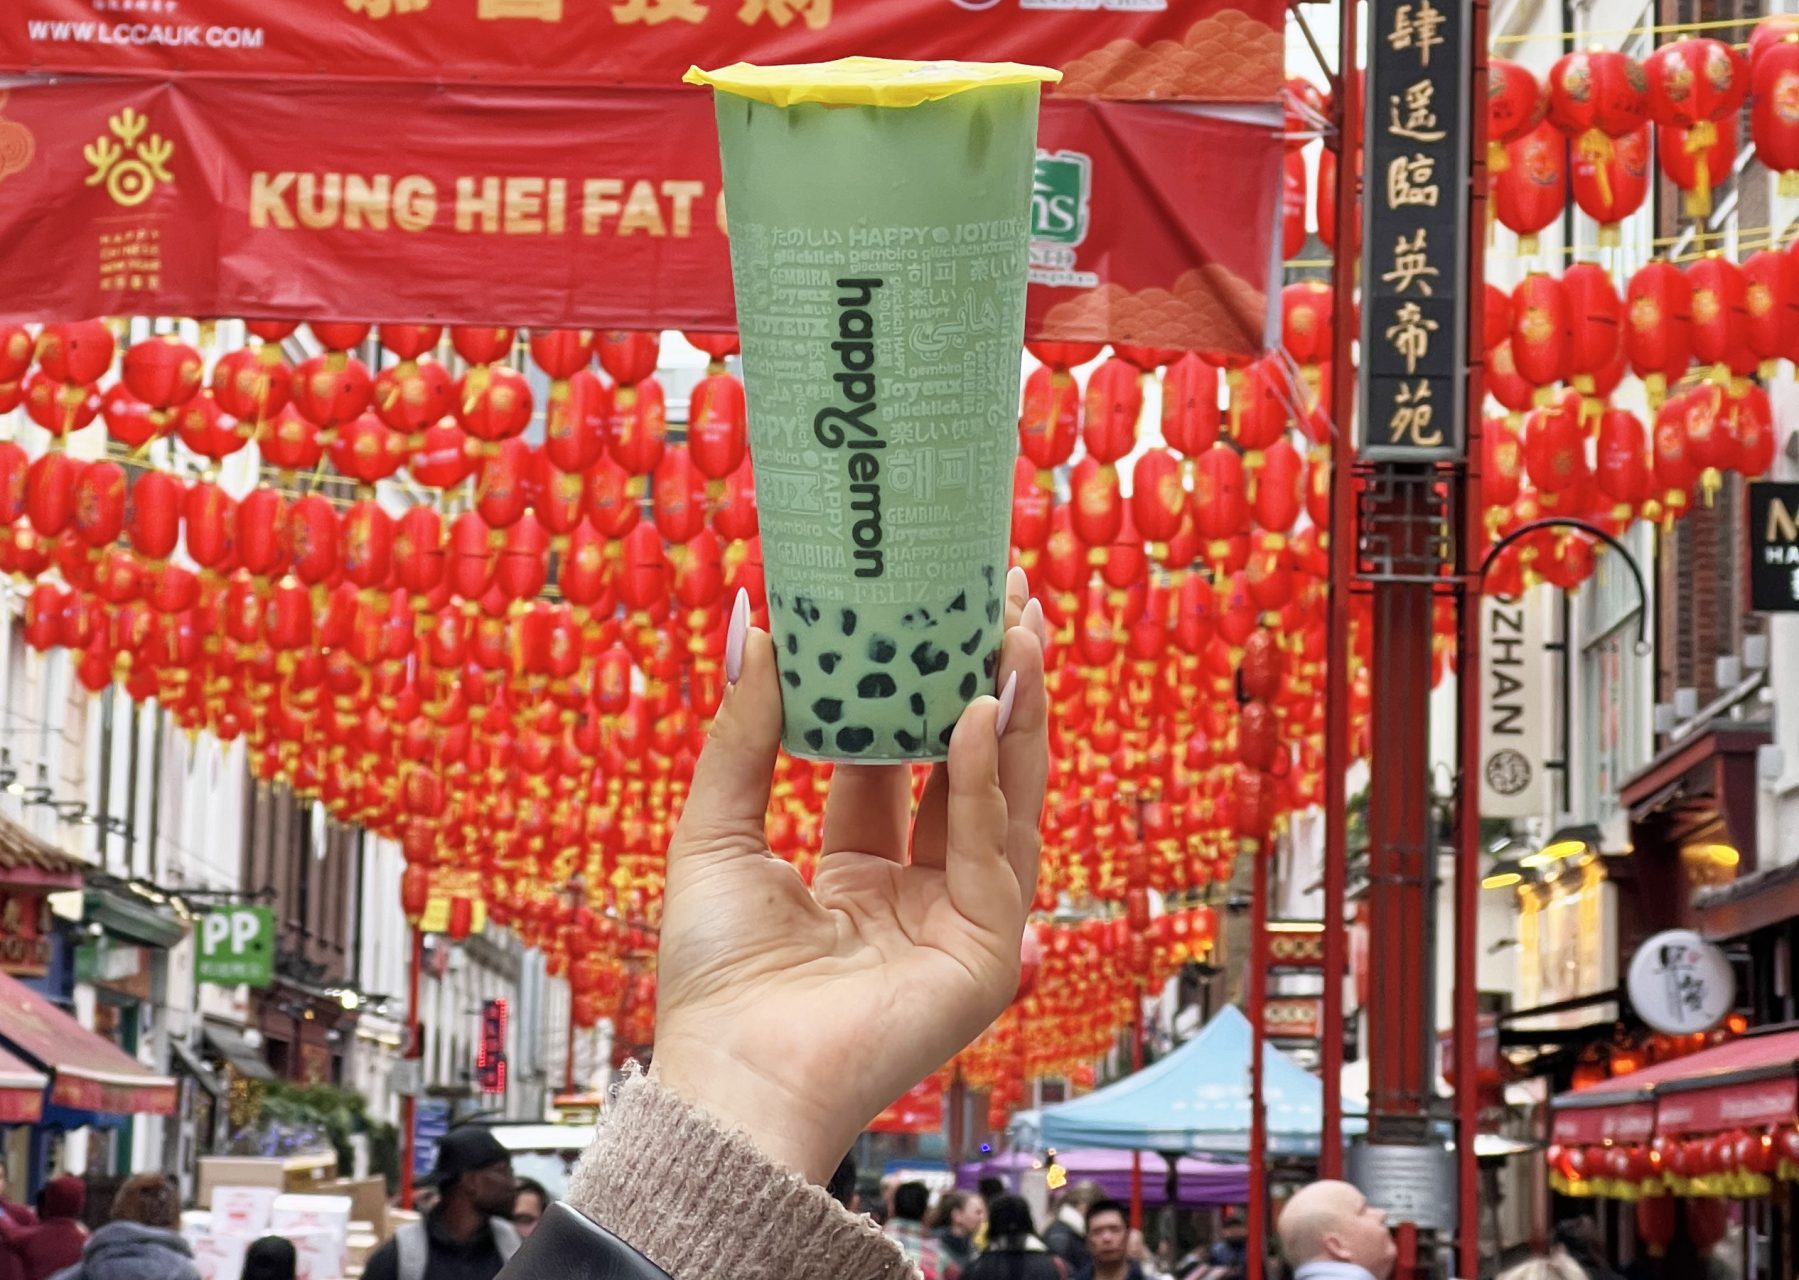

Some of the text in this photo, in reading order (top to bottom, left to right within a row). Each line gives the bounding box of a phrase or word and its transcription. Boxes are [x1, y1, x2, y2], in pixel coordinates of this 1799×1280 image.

[250, 171, 439, 232] KUNG
[455, 175, 566, 235] HEI
[583, 178, 704, 237] FAT
[849, 226, 931, 247] HAPPY
[770, 267, 832, 286] GEMBIRA
[821, 451, 846, 542] HAPPY
[1492, 593, 1524, 735] ZHAN
